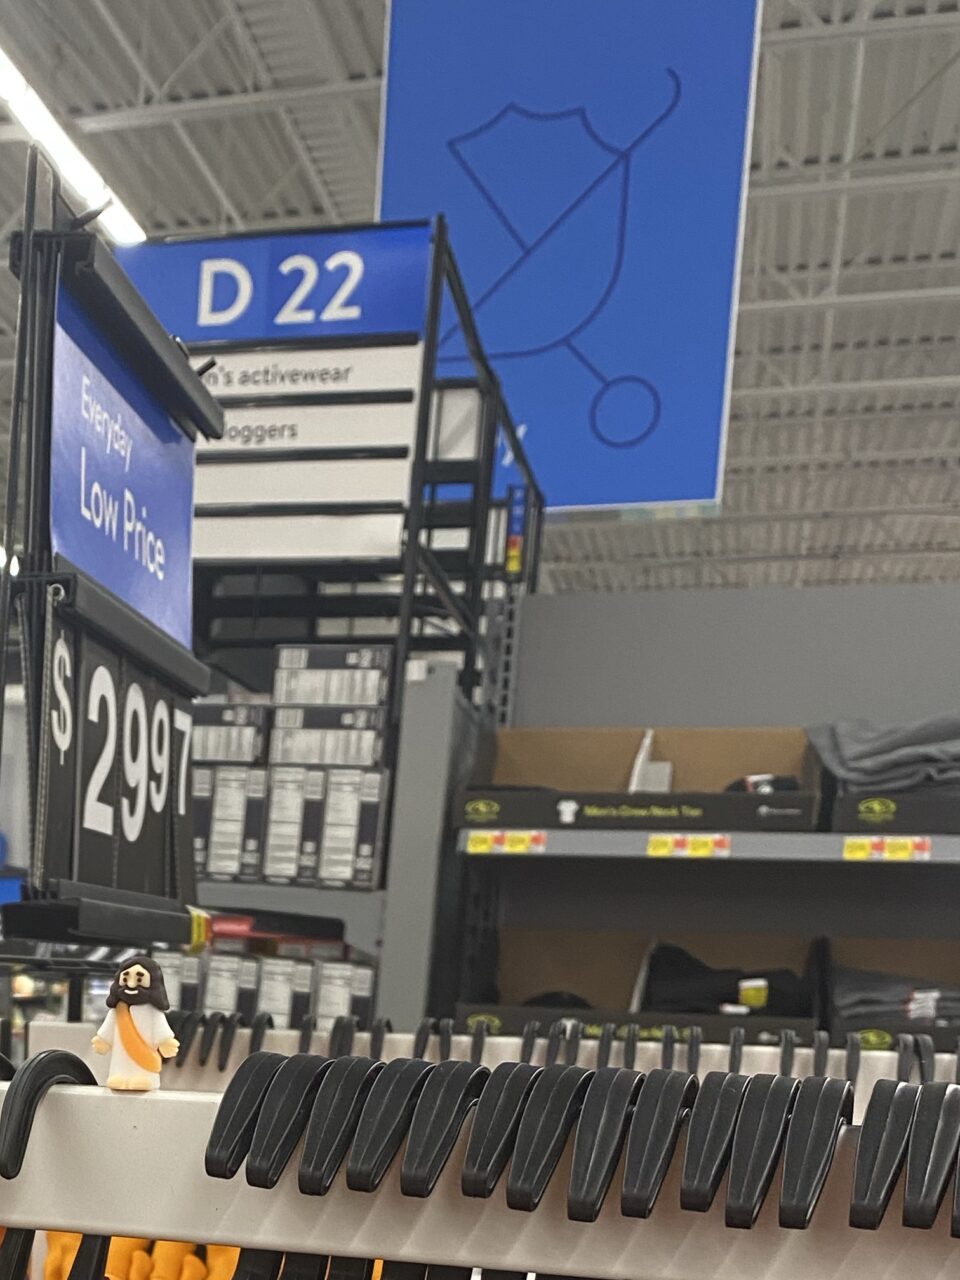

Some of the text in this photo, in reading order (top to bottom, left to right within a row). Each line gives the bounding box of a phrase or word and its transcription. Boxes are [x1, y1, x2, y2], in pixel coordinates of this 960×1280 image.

[197, 250, 365, 327] D 22
[237, 363, 352, 386] activewear
[82, 374, 133, 472] Everyday
[225, 424, 298, 444] oggers
[81, 446, 165, 581] Low Price
